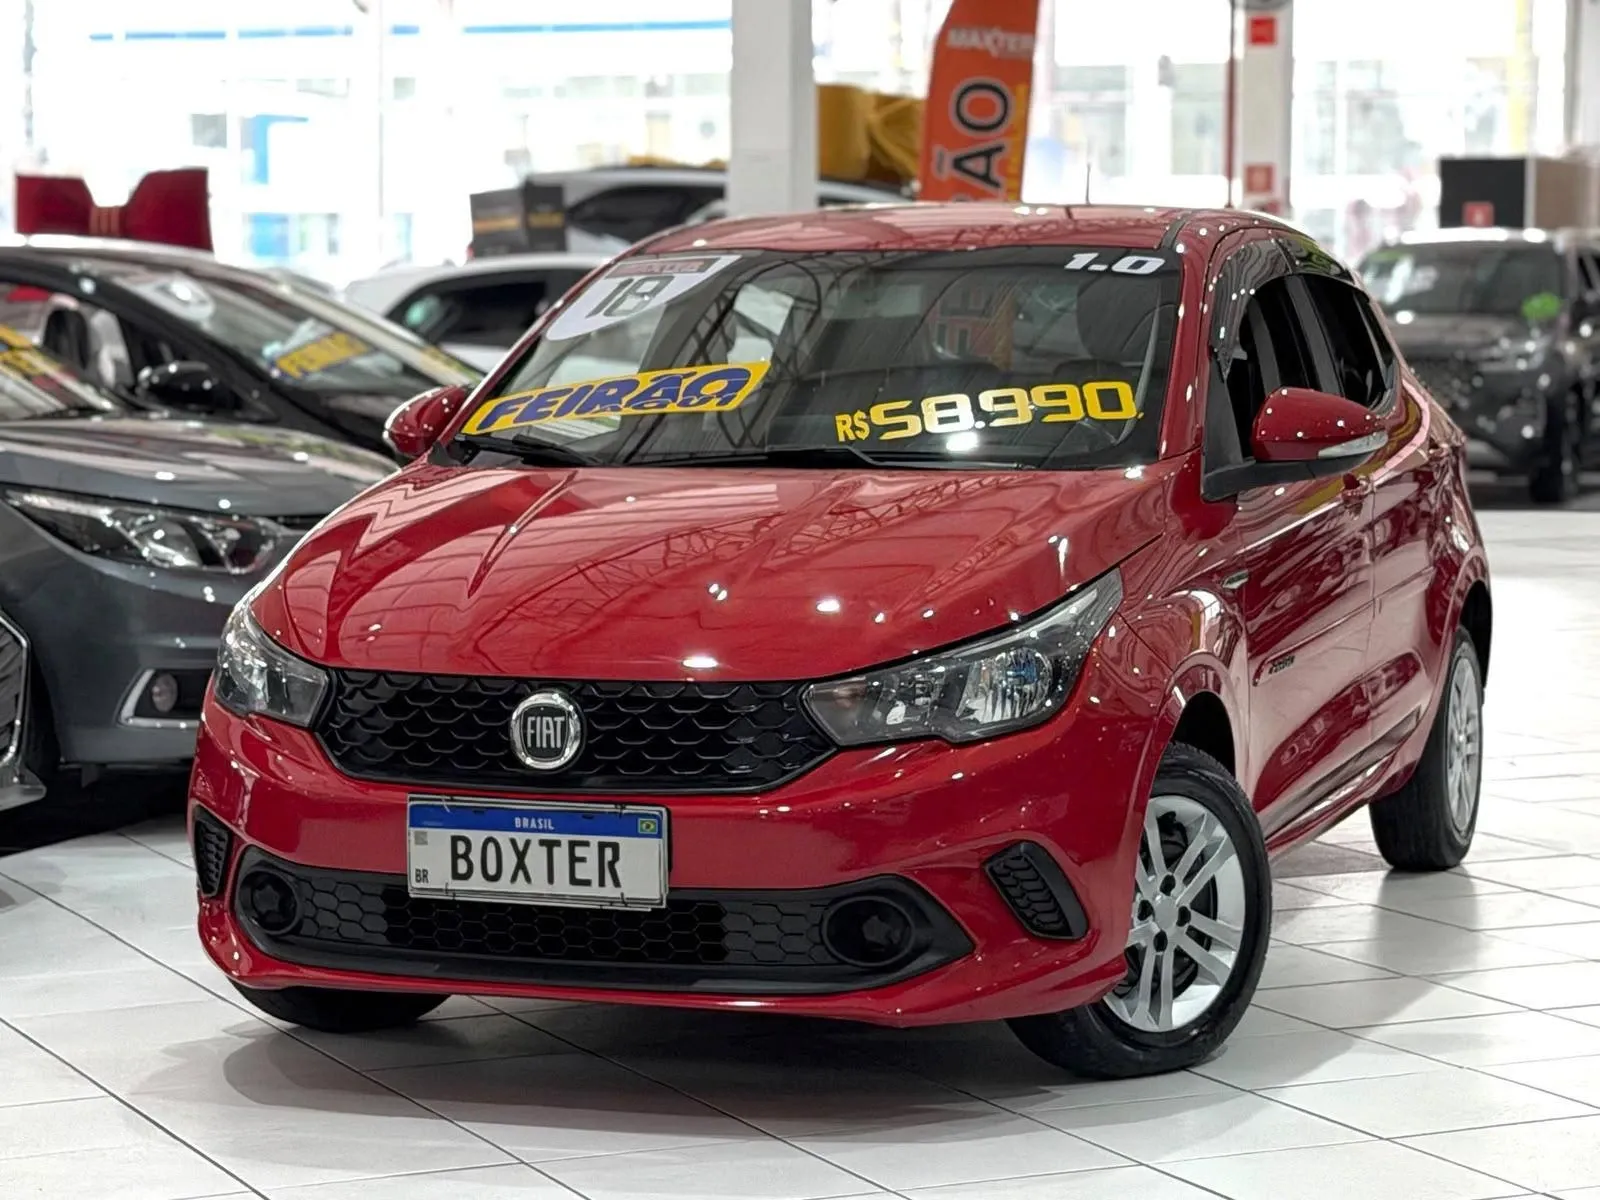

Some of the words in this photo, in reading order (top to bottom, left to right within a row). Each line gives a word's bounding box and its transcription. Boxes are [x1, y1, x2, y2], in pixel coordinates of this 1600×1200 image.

[931, 76, 1016, 203] ÃO
[1064, 252, 1166, 275] 1.0
[585, 267, 676, 319] 18
[475, 366, 753, 431] FEIRÃO
[526, 715, 566, 748] FIAT
[514, 816, 555, 831] BRASIL
[414, 867, 430, 884] BR
[450, 834, 623, 889] BOXTER
